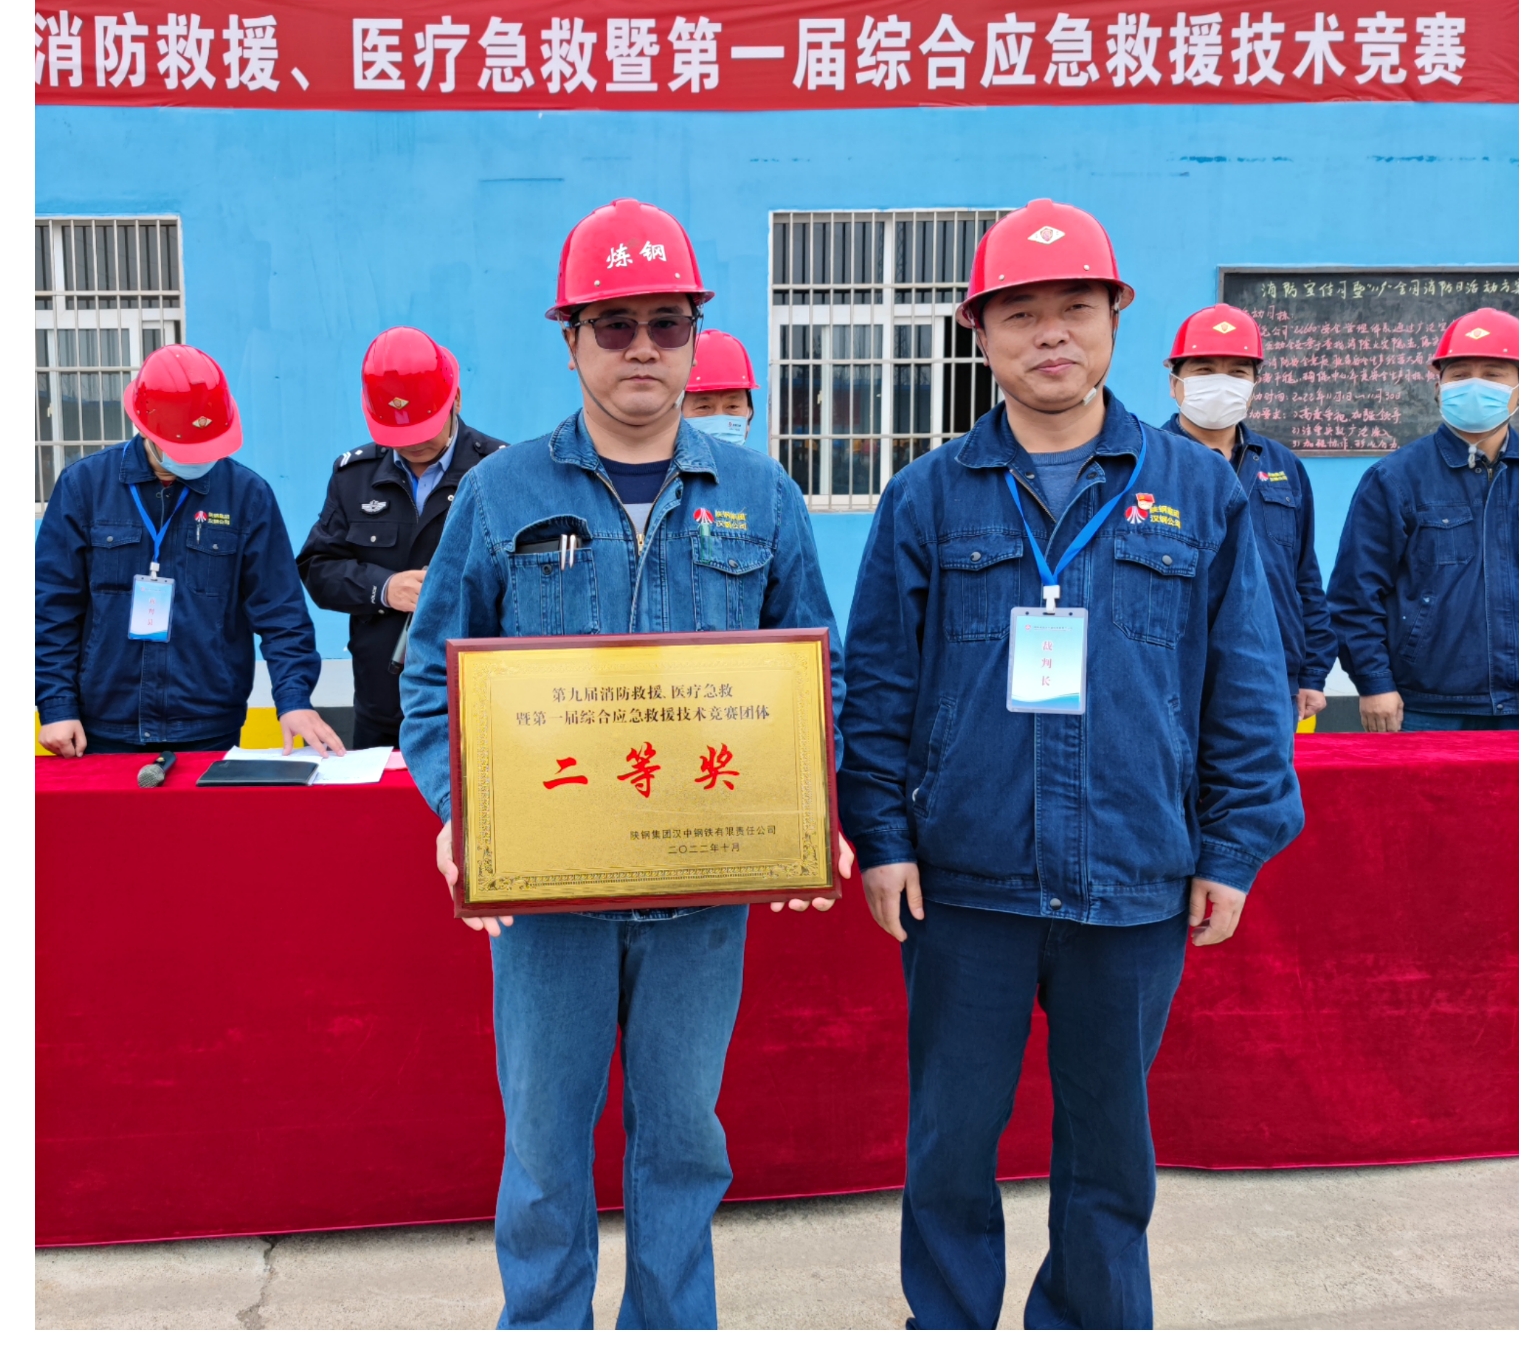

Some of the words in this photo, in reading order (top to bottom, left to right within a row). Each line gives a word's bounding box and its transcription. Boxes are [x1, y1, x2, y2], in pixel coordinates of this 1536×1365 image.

[605, 240, 667, 270] 炼钢
[551, 683, 733, 704] 第九届消防救援、医疗急救
[515, 706, 771, 727] 暨第一届综合应急救援技术竞赛团体
[542, 741, 741, 798] 二等奖
[629, 824, 777, 841] 陕钢集团汉中钢铁有限责任公司
